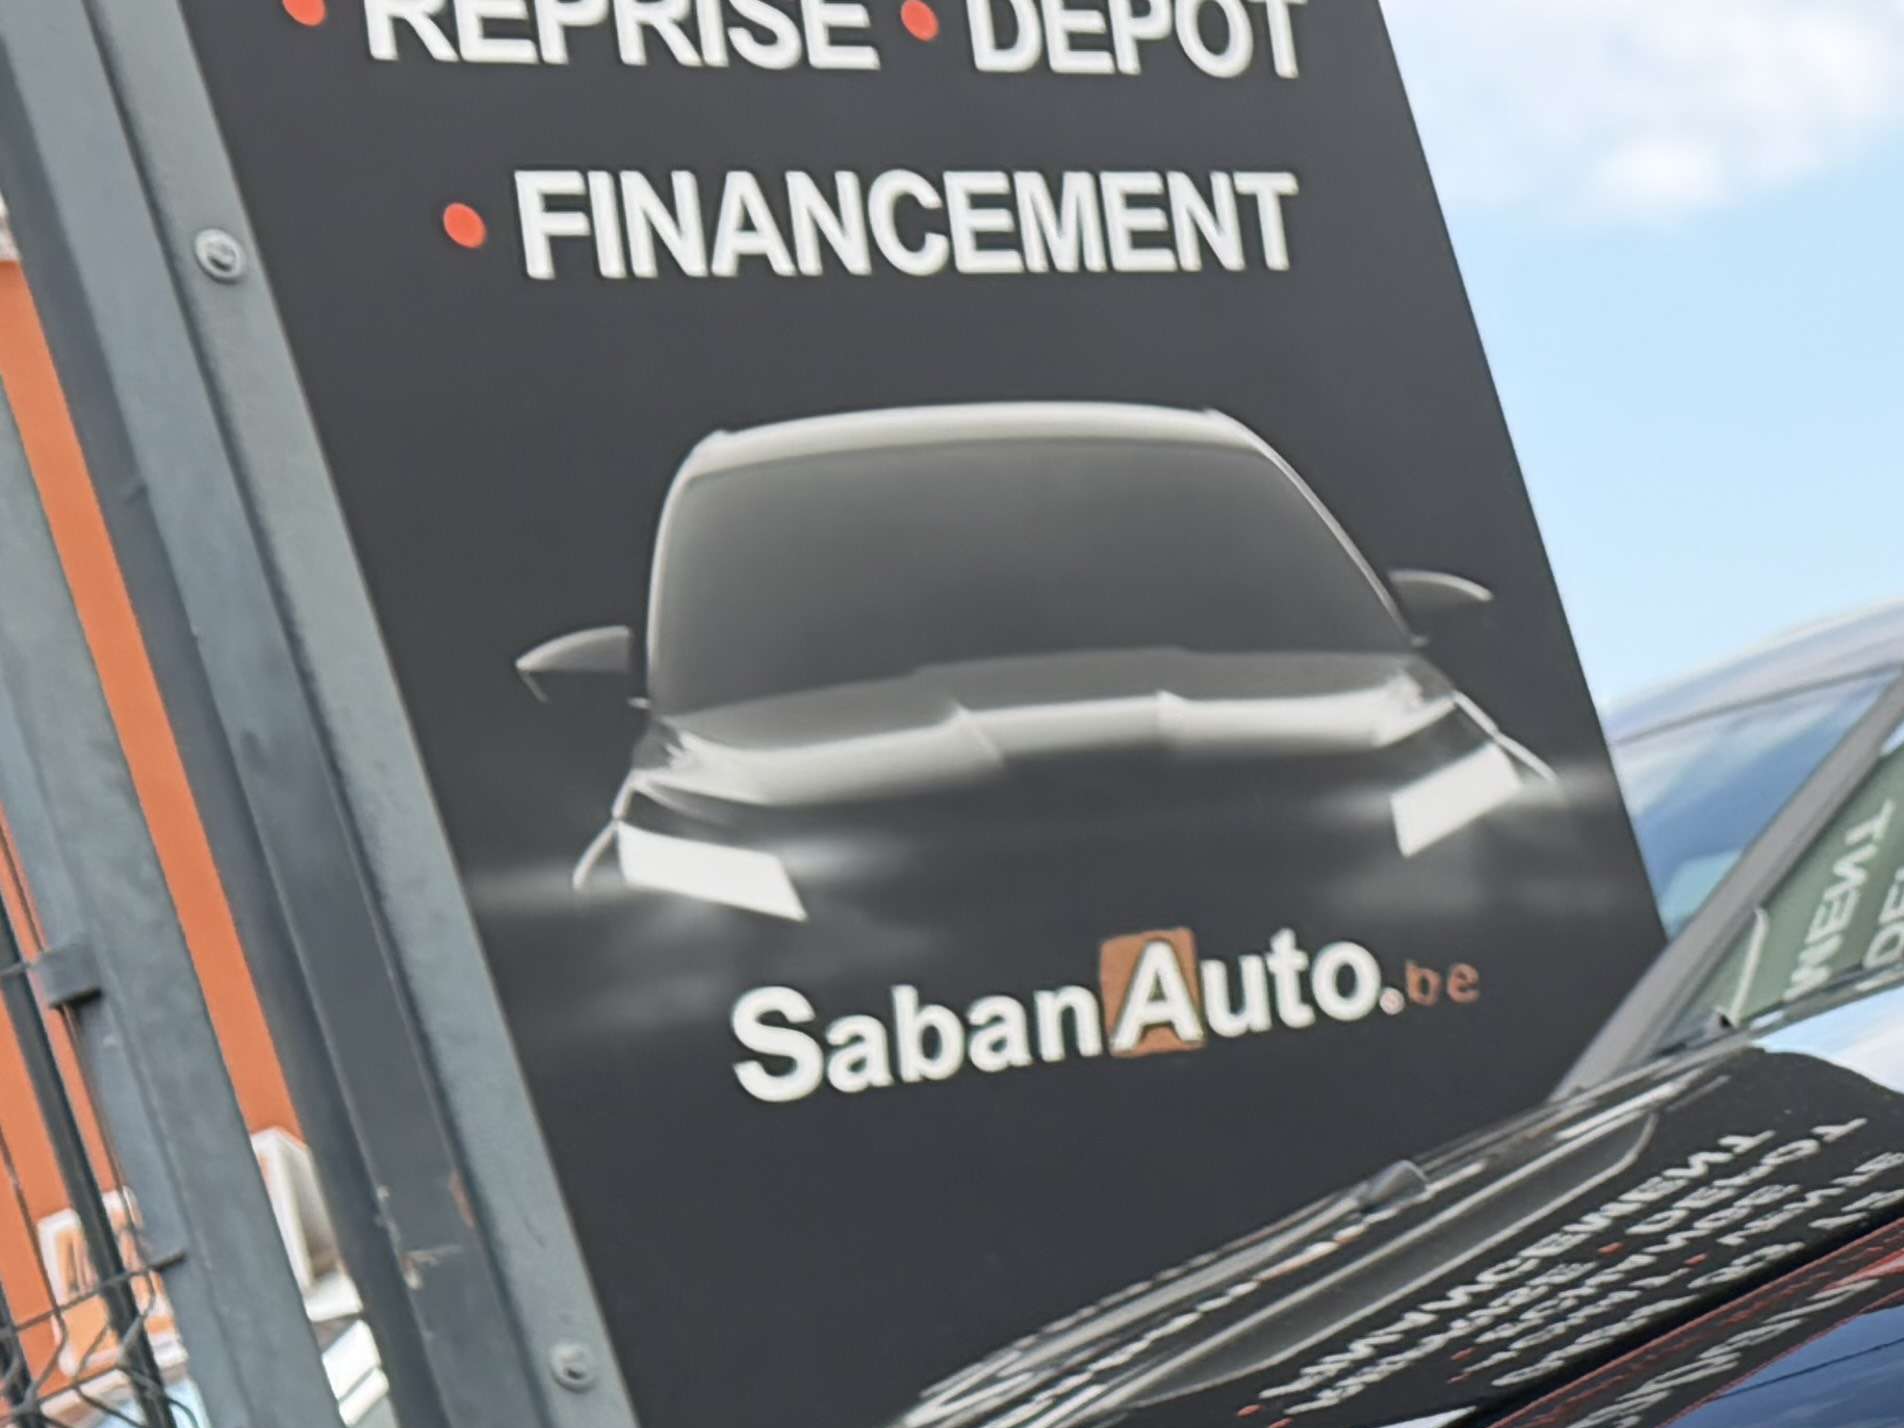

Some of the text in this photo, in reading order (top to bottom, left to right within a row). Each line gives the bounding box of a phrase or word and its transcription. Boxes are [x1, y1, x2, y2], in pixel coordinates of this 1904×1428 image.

[364, 0, 880, 70] REPRISE
[513, 169, 1300, 279] FINANCEMENT
[730, 927, 1480, 1103] SabanAuto.be
